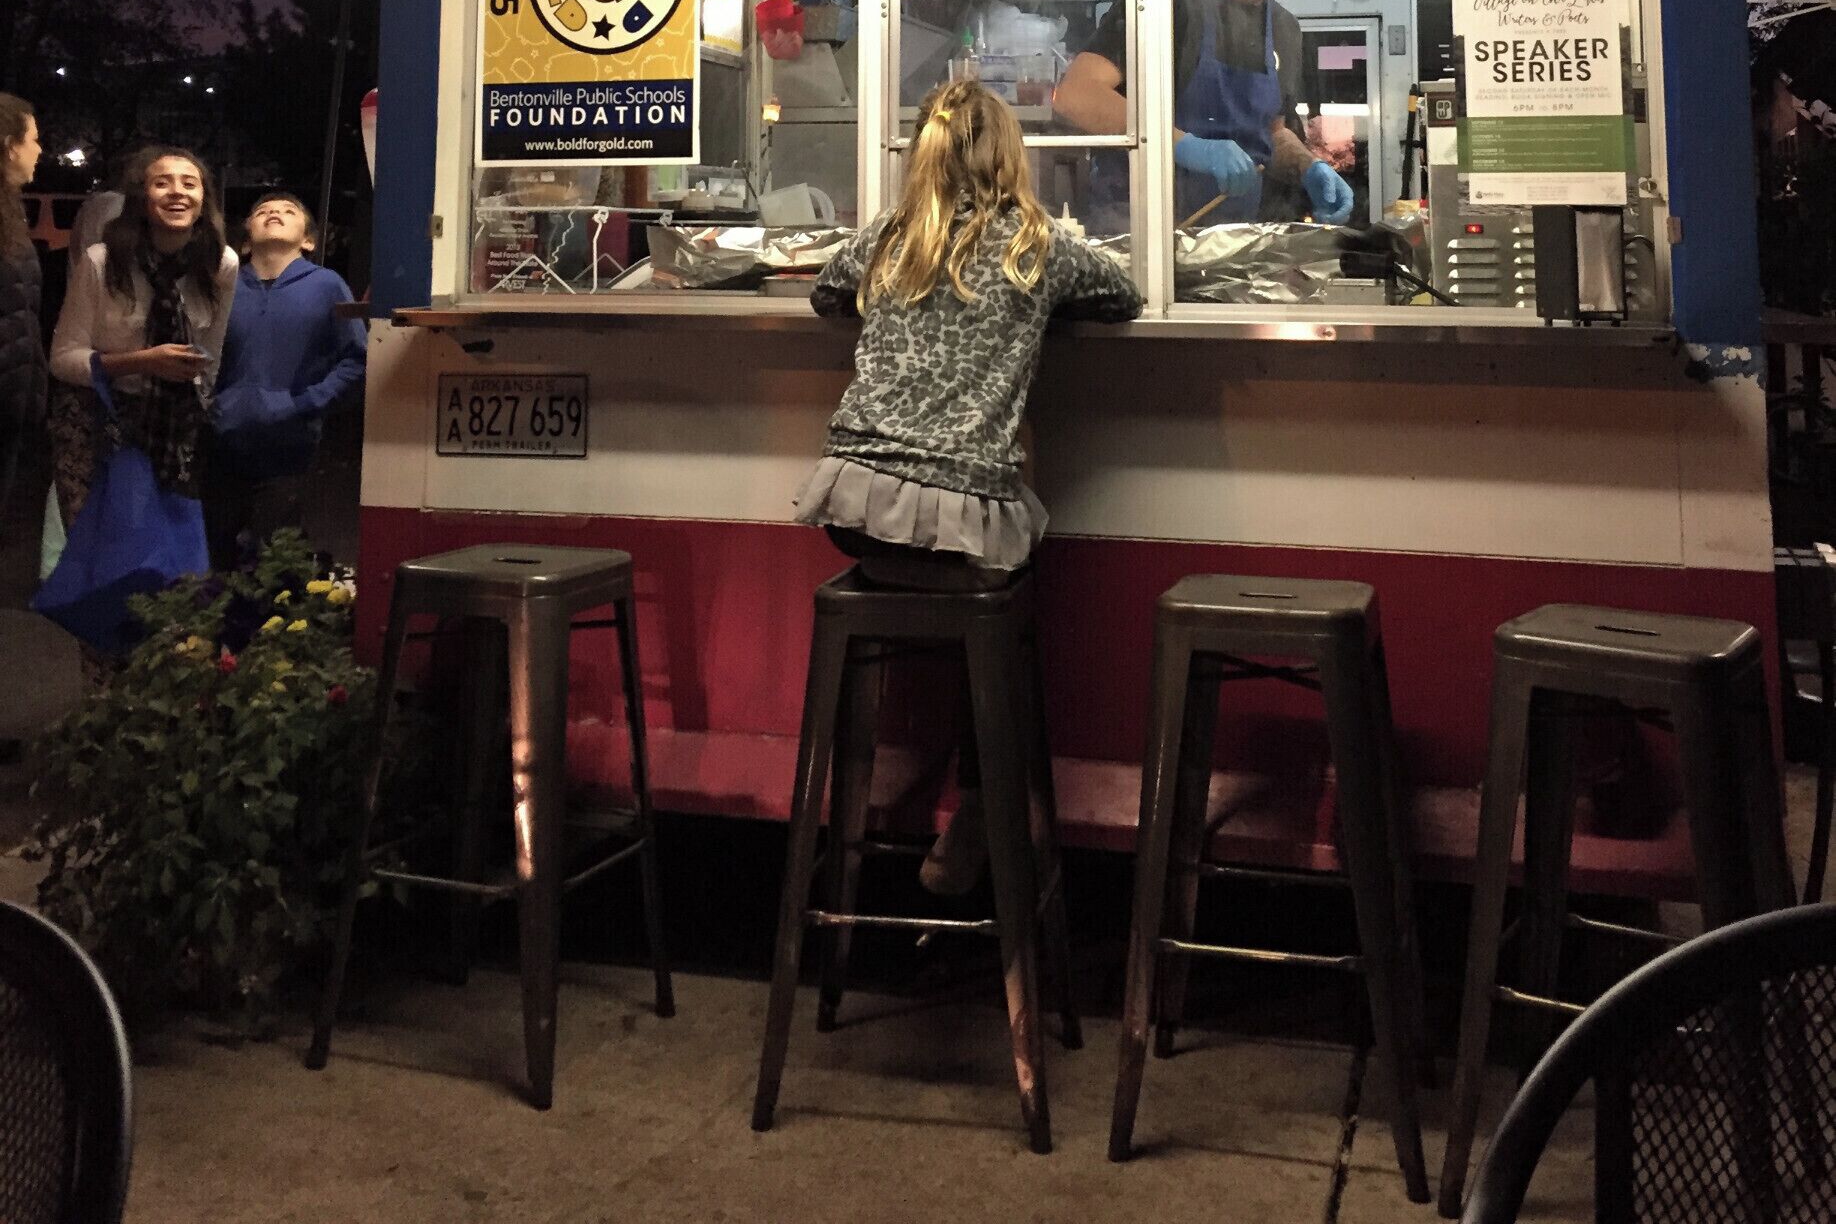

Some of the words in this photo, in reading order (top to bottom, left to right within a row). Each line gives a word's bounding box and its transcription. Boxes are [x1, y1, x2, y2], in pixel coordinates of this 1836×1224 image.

[1541, 13, 1556, 26] &
[1556, 8, 1590, 26] Poets
[1474, 38, 1609, 62] SPEAKER
[1492, 60, 1592, 83] SERIES
[490, 89, 573, 107] Bentonville
[576, 87, 622, 105] Public
[625, 85, 686, 104] Schools
[490, 105, 686, 126] FOUNDATION
[1513, 104, 1534, 112] 6PM
[1552, 103, 1574, 111] 8PM
[525, 137, 653, 153] www.boldforgold.com
[471, 379, 555, 393] ARKANSAS
[469, 394, 520, 437] 827
[530, 394, 582, 438] 659
[505, 440, 552, 451] TRAILER
